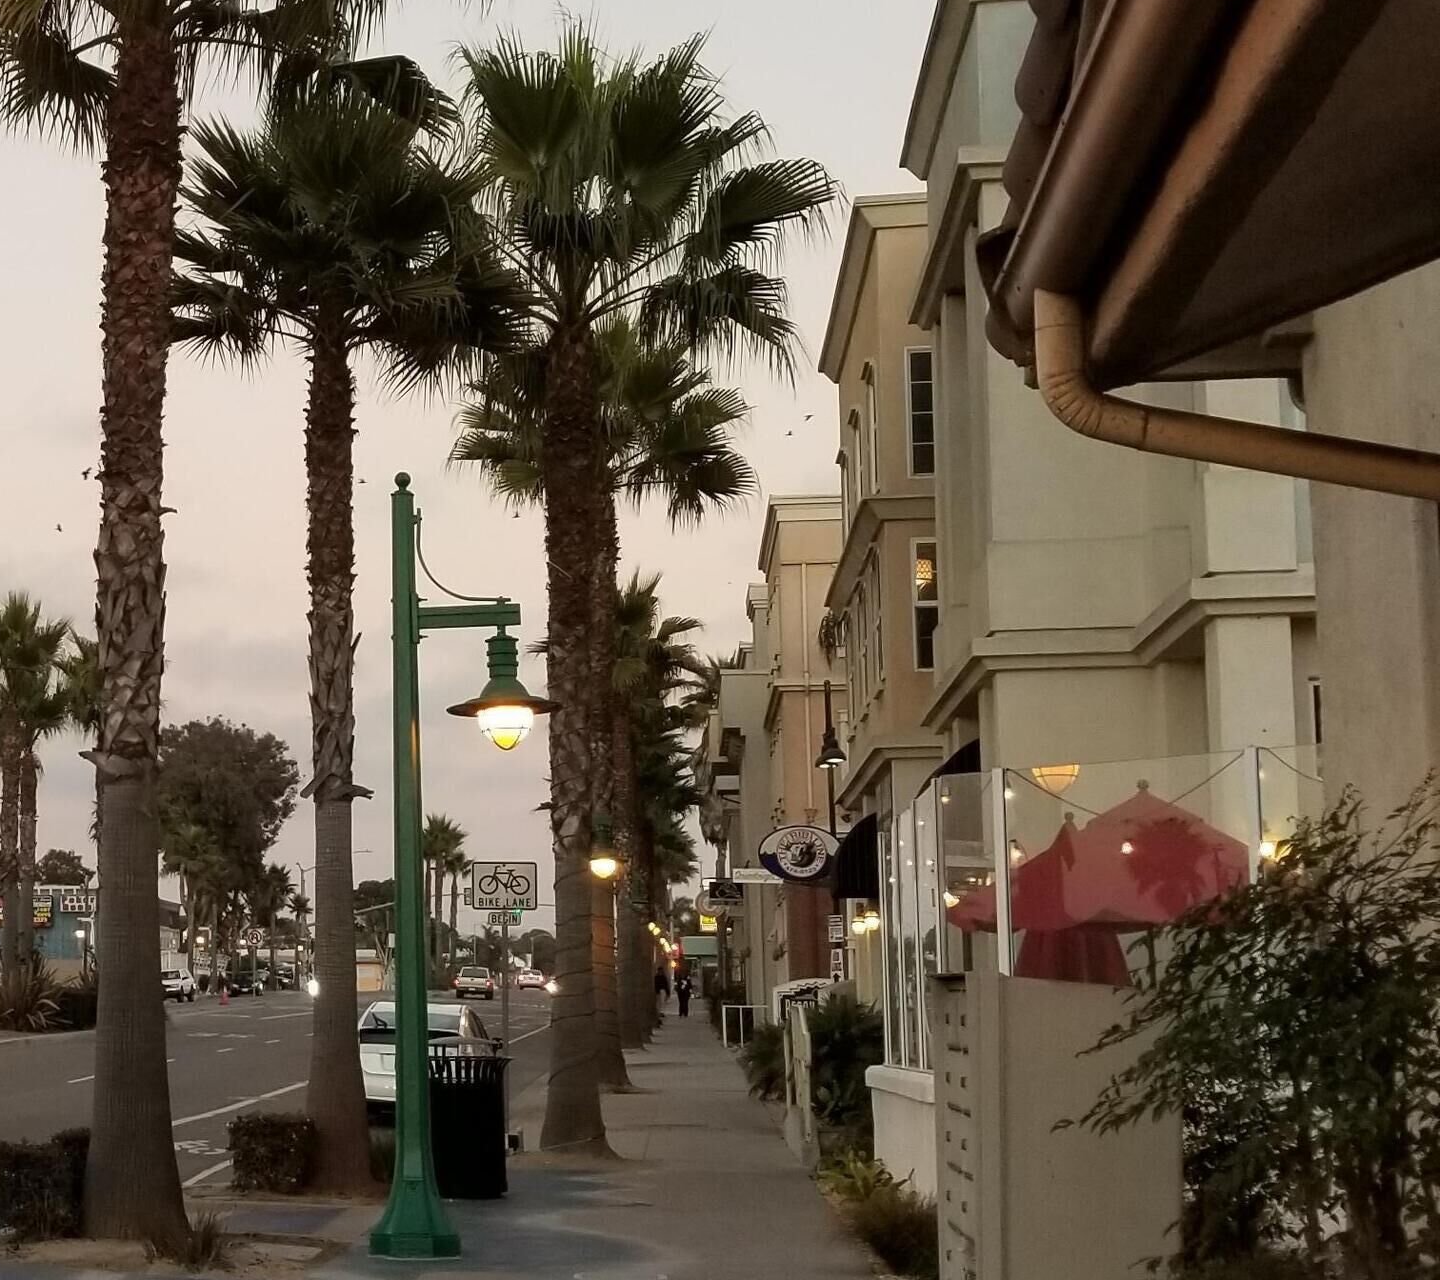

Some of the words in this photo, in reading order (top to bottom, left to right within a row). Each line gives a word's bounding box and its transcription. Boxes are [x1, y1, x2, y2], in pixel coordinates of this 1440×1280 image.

[478, 898, 500, 907] BIKE
[506, 898, 531, 908] LANE
[491, 914, 518, 924] BEGIN
